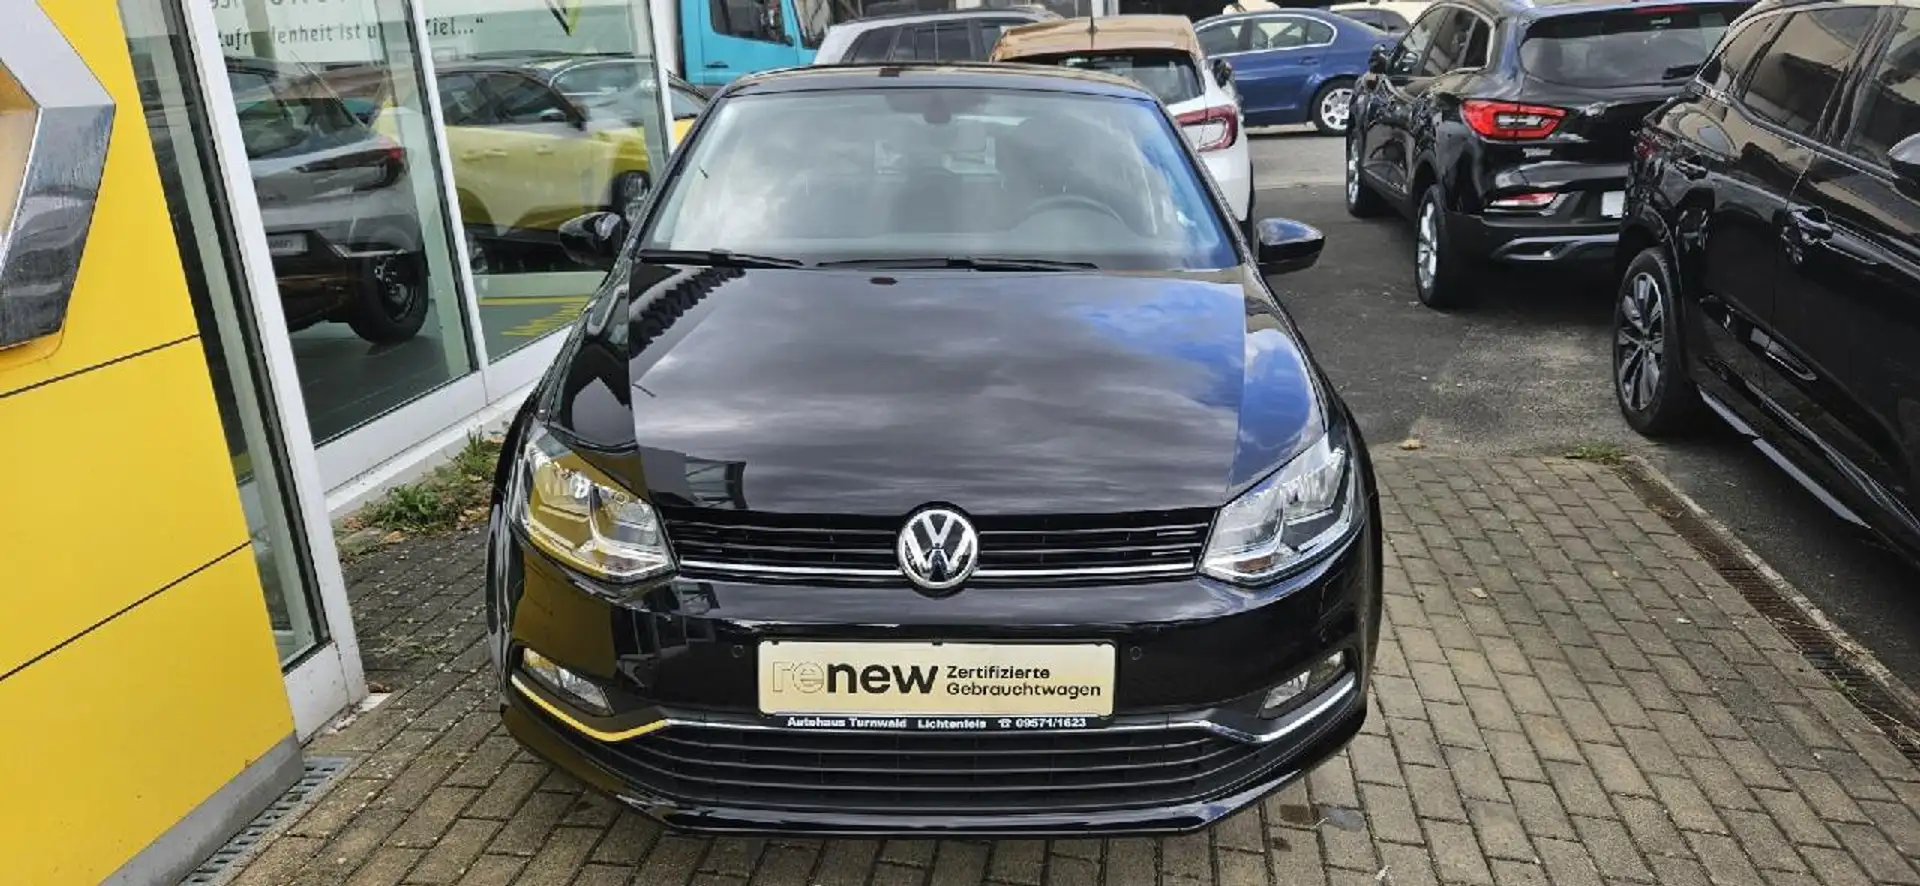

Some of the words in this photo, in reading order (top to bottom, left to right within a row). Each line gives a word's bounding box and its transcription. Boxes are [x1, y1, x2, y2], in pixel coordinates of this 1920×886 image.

[901, 511, 976, 586] VW
[771, 661, 939, 694] renew
[946, 665, 1050, 680] Zertifizierte
[946, 682, 1101, 700] Gebrauchtwagen
[787, 716, 846, 727] Autohaus
[848, 717, 907, 728] Turnwald
[917, 718, 987, 729] Lichtenfels
[1015, 718, 1087, 728] 09571/1623
